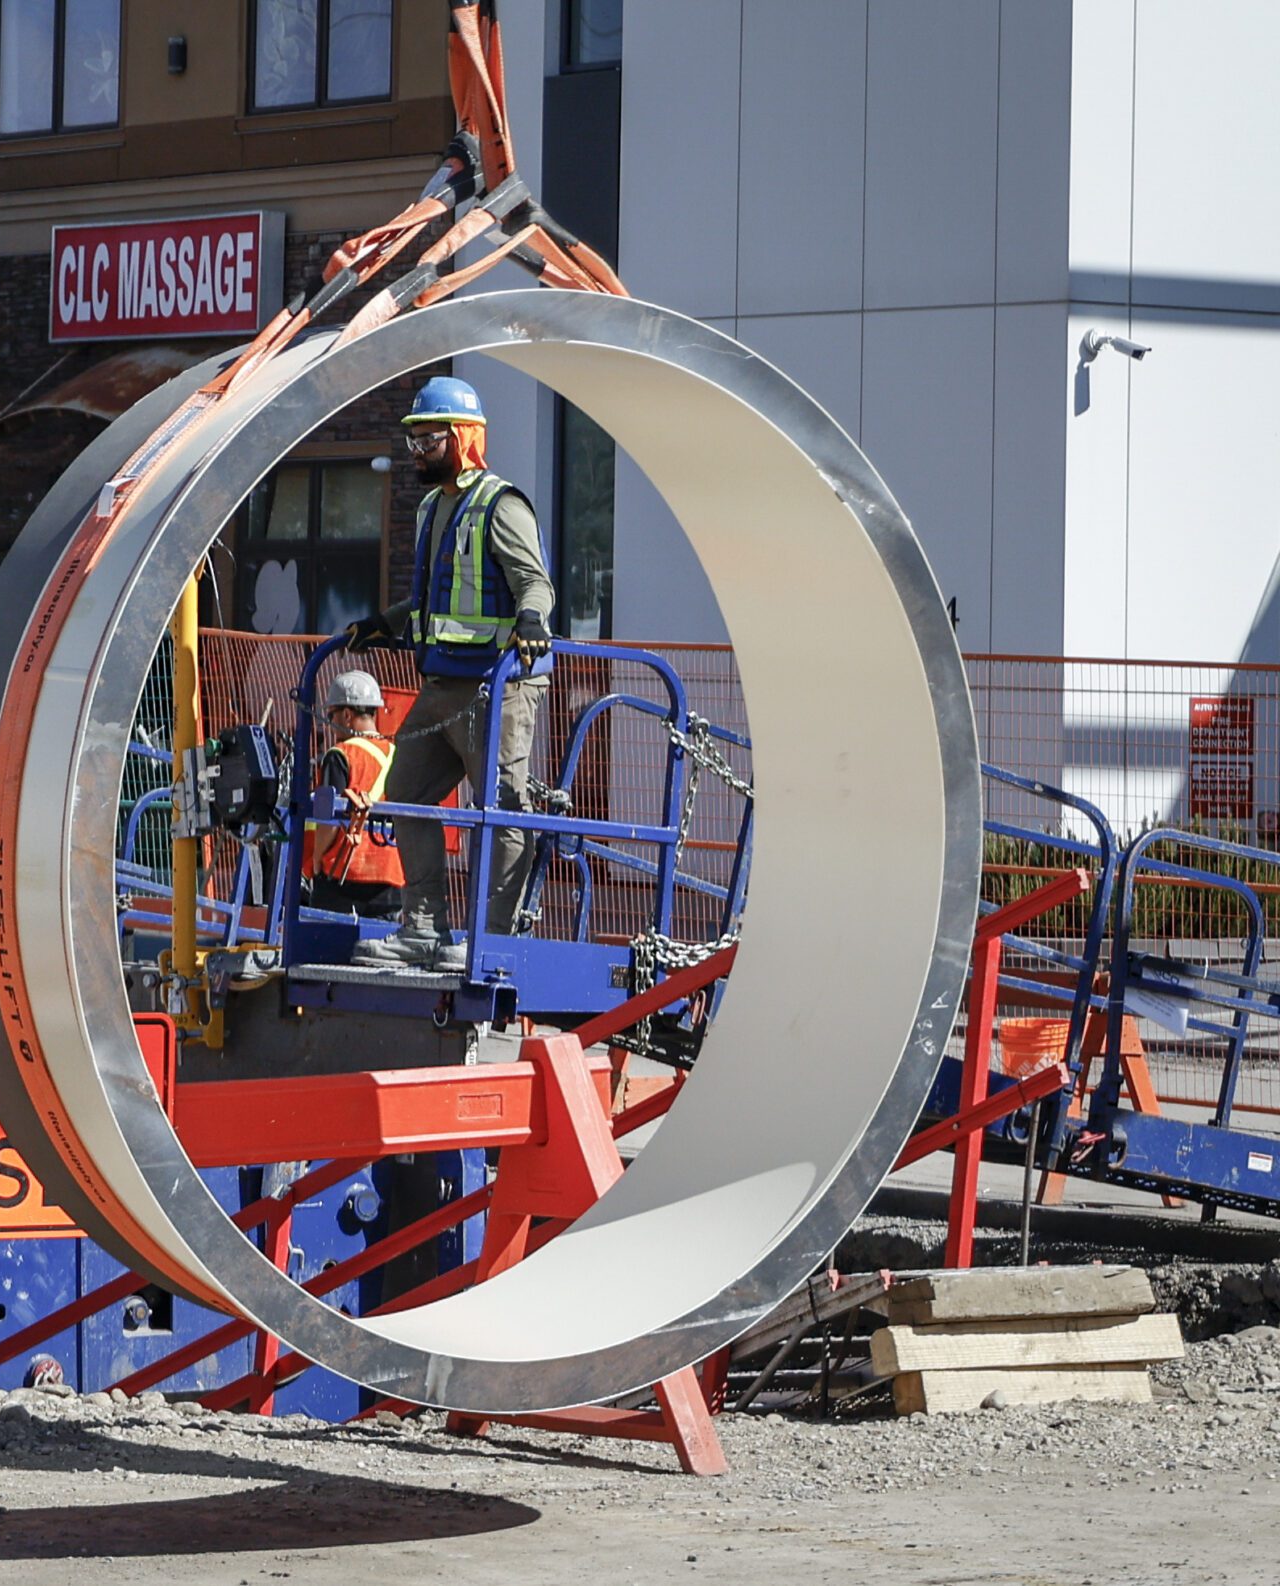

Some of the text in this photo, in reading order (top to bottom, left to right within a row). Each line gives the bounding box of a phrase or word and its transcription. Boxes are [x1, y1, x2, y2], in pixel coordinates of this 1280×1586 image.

[58, 231, 254, 324] CLC MASSAGE
[1194, 704, 1213, 712] AUTO
[1192, 728, 1250, 736] DEPARTMENT
[1193, 738, 1249, 748] CONNECTION
[1201, 768, 1242, 778] NOTICE
